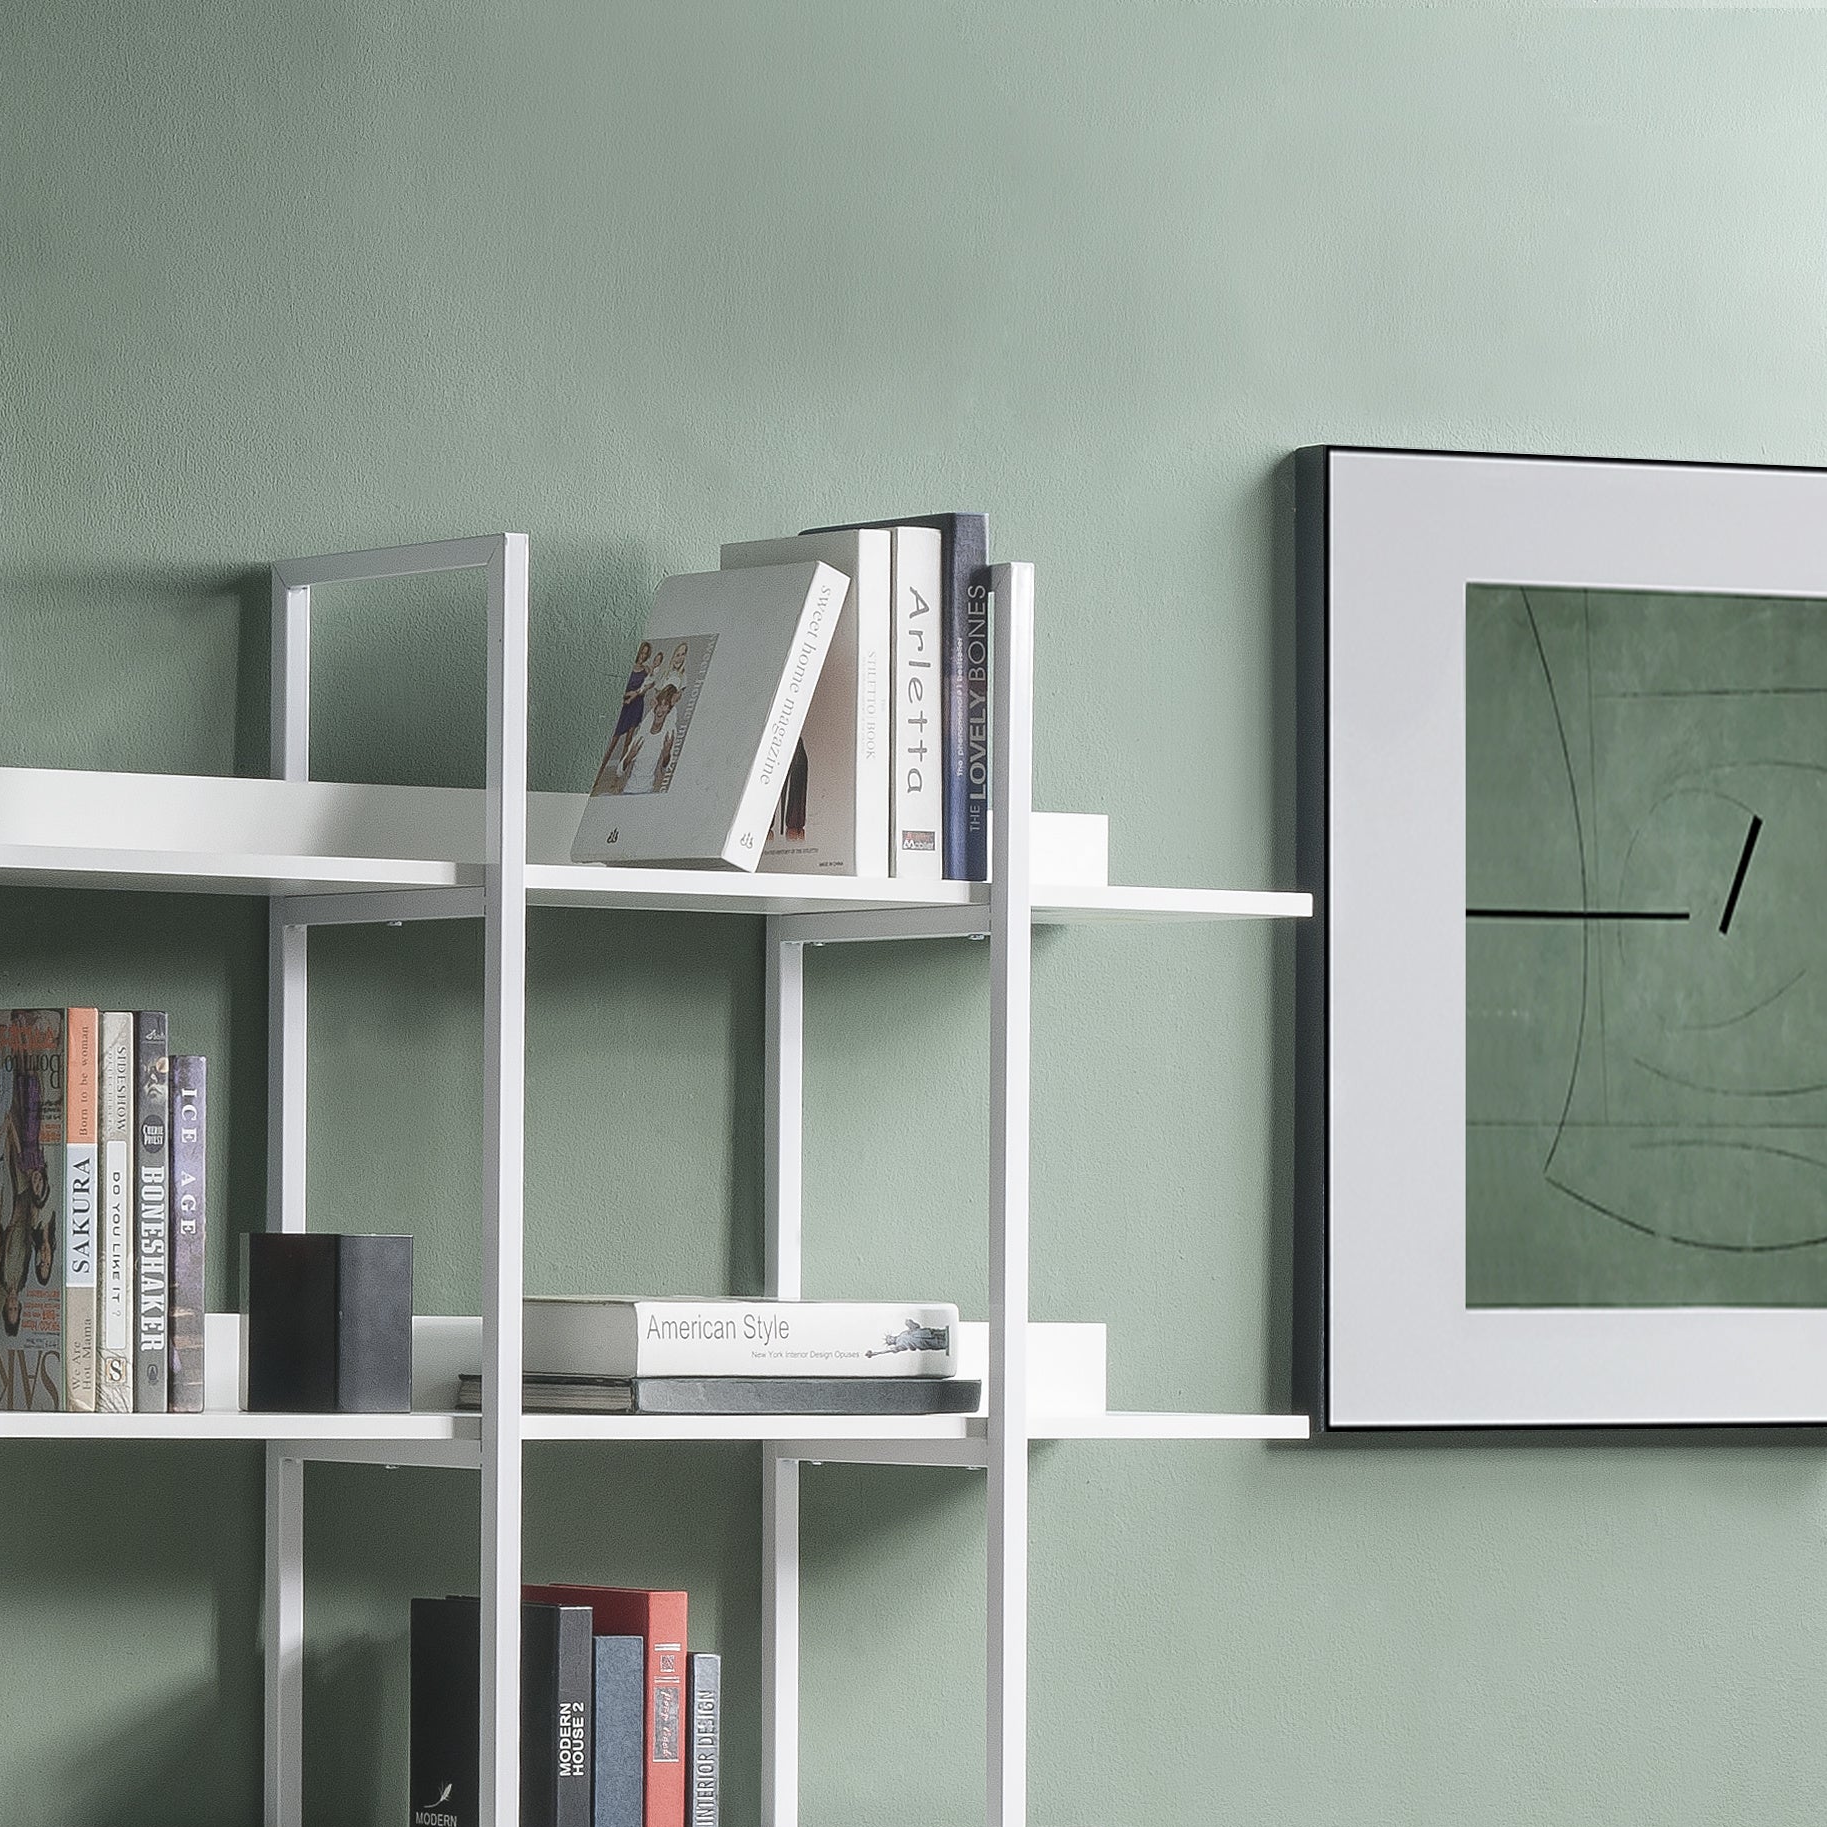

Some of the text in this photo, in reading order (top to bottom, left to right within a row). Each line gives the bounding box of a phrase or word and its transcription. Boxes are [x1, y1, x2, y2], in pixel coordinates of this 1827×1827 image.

[760, 585, 831, 785] sweet home magazine
[906, 586, 931, 793] Arletta
[967, 585, 987, 832] THE LOVELY BONES
[866, 721, 876, 760] BOOK
[79, 1026, 89, 1136] Born to be woman
[116, 1046, 127, 1133] SIDESHOW
[112, 1172, 121, 1195] DO
[180, 1088, 198, 1235] ICE AGE
[72, 1157, 91, 1273] SAKURA
[112, 1202, 121, 1236] YOU
[112, 1243, 120, 1281] LIKE
[141, 1165, 165, 1351] BONESHAKER
[112, 1288, 120, 1302] IT
[646, 1314, 790, 1346] American Style
[72, 1341, 81, 1391] We Are
[83, 1318, 91, 1391] Hot Mama
[810, 1351, 833, 1359] Design
[559, 1702, 571, 1777] MODERN
[572, 1701, 584, 1777] HOUSE 2
[697, 1689, 716, 1749] DESIGN
[416, 1811, 458, 1827] MODERN
[696, 1753, 715, 1826] INTERIOR
